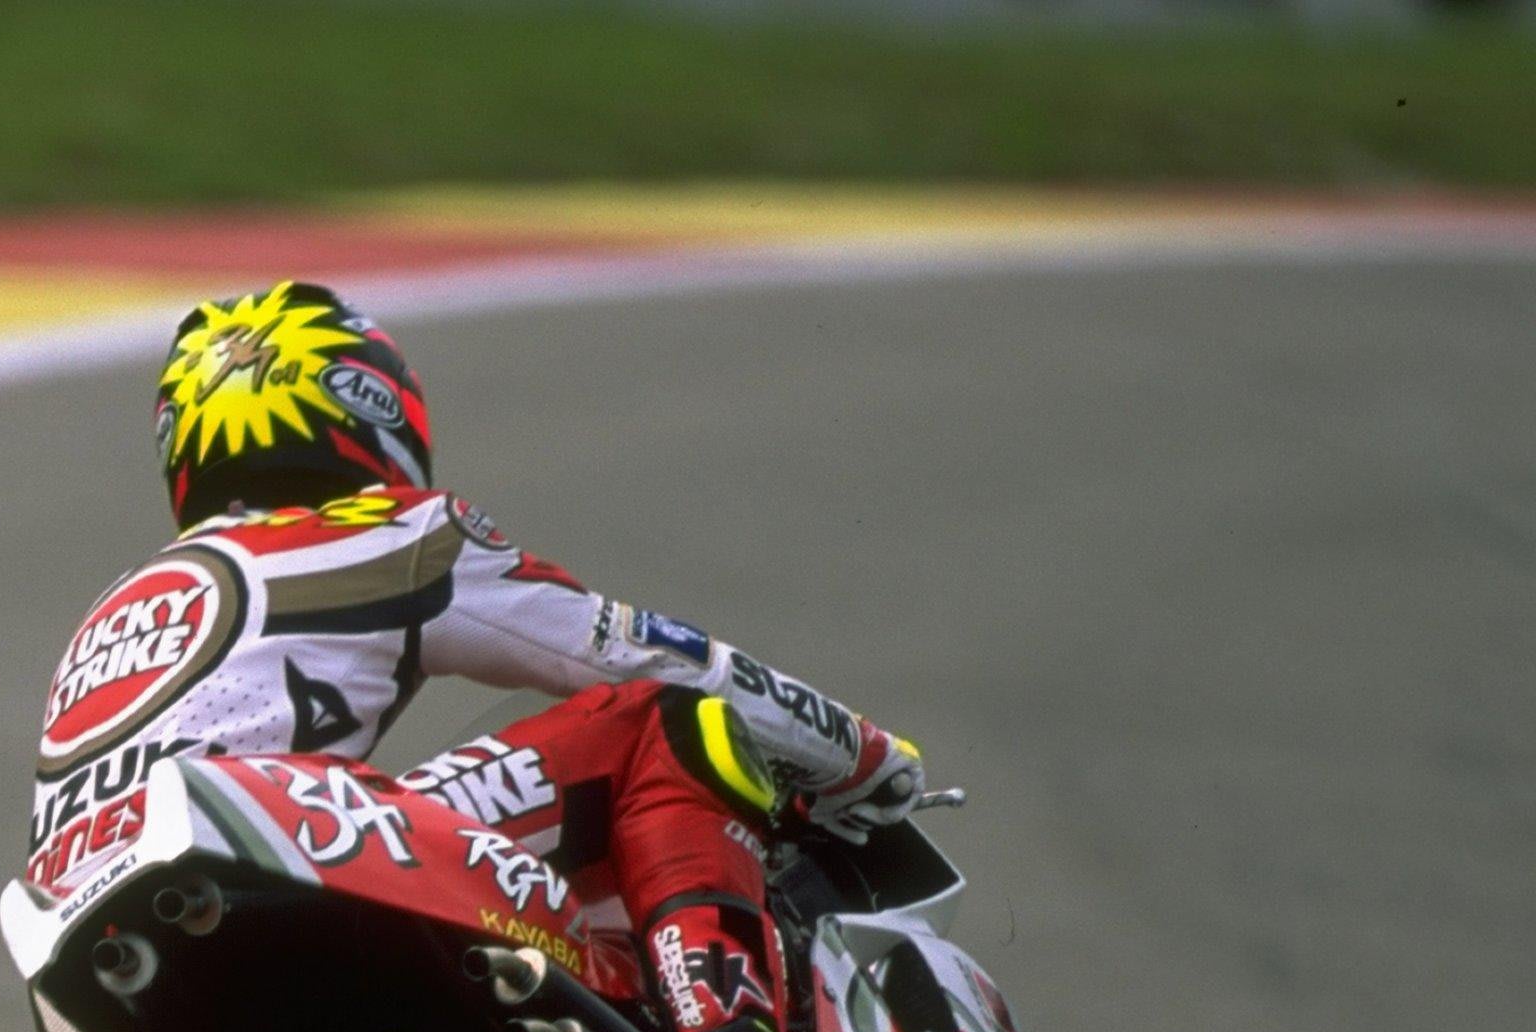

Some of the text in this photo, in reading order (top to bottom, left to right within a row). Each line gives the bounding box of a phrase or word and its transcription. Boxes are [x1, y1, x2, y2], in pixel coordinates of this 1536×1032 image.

[330, 371, 398, 418] Arai
[58, 586, 209, 685] LUCKY
[44, 624, 192, 731] STRIKE
[30, 739, 227, 856] UZUK
[244, 758, 421, 868] 34
[425, 747, 556, 825] IKE
[60, 854, 138, 921] SUZUKI
[457, 829, 569, 911] RGV
[480, 908, 582, 975] KAYABA
